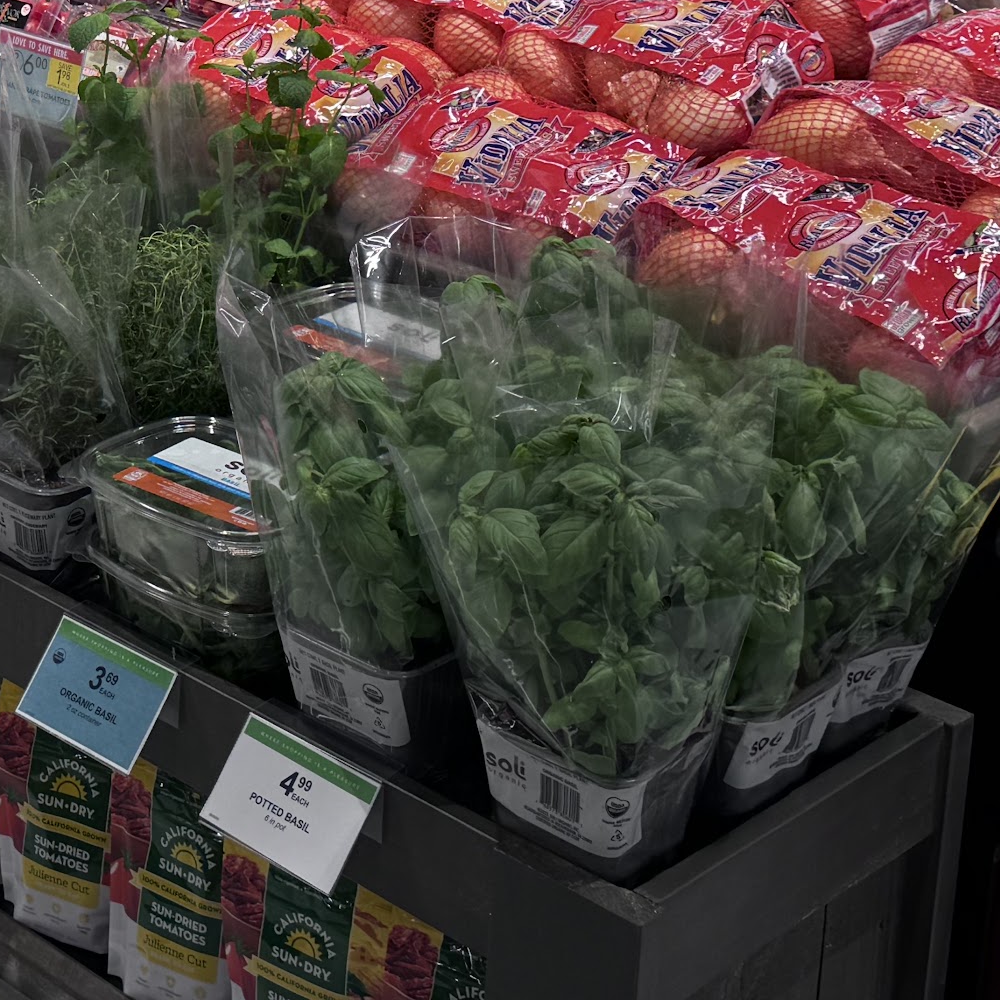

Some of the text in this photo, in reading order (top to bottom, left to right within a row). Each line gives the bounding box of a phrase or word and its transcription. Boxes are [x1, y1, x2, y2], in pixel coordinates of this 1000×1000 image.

[12, 36, 27, 48] LOVE
[28, 40, 36, 50] TO
[38, 43, 52, 56] SAVE
[58, 62, 73, 72] SAVE
[41, 91, 71, 106] TOMATOES
[59, 687, 118, 726] ORGANIC BASIL
[66, 704, 73, 712] 2
[99, 686, 116, 701] EACH
[39, 757, 101, 800] CALIFORNIA
[485, 751, 527, 782] soli
[249, 791, 311, 835] POTTED BASIL
[291, 793, 310, 808] EACH
[41, 815, 82, 837] CALIFORNIA
[82, 829, 108, 844] GROWN
[263, 813, 270, 822] 6
[33, 844, 89, 874] TOMATOES
[34, 833, 91, 862] SUN-DRIED
[160, 825, 217, 871] CALIFORNIA
[27, 864, 91, 896] Julienne Cut
[141, 873, 160, 890] 100%
[160, 884, 198, 908] CALIFORNIA
[149, 912, 207, 947] TOMATOES
[150, 900, 208, 935] SUN-DRIED
[273, 911, 337, 961] CALIFORNIA
[143, 934, 208, 970] Julienne Cut
